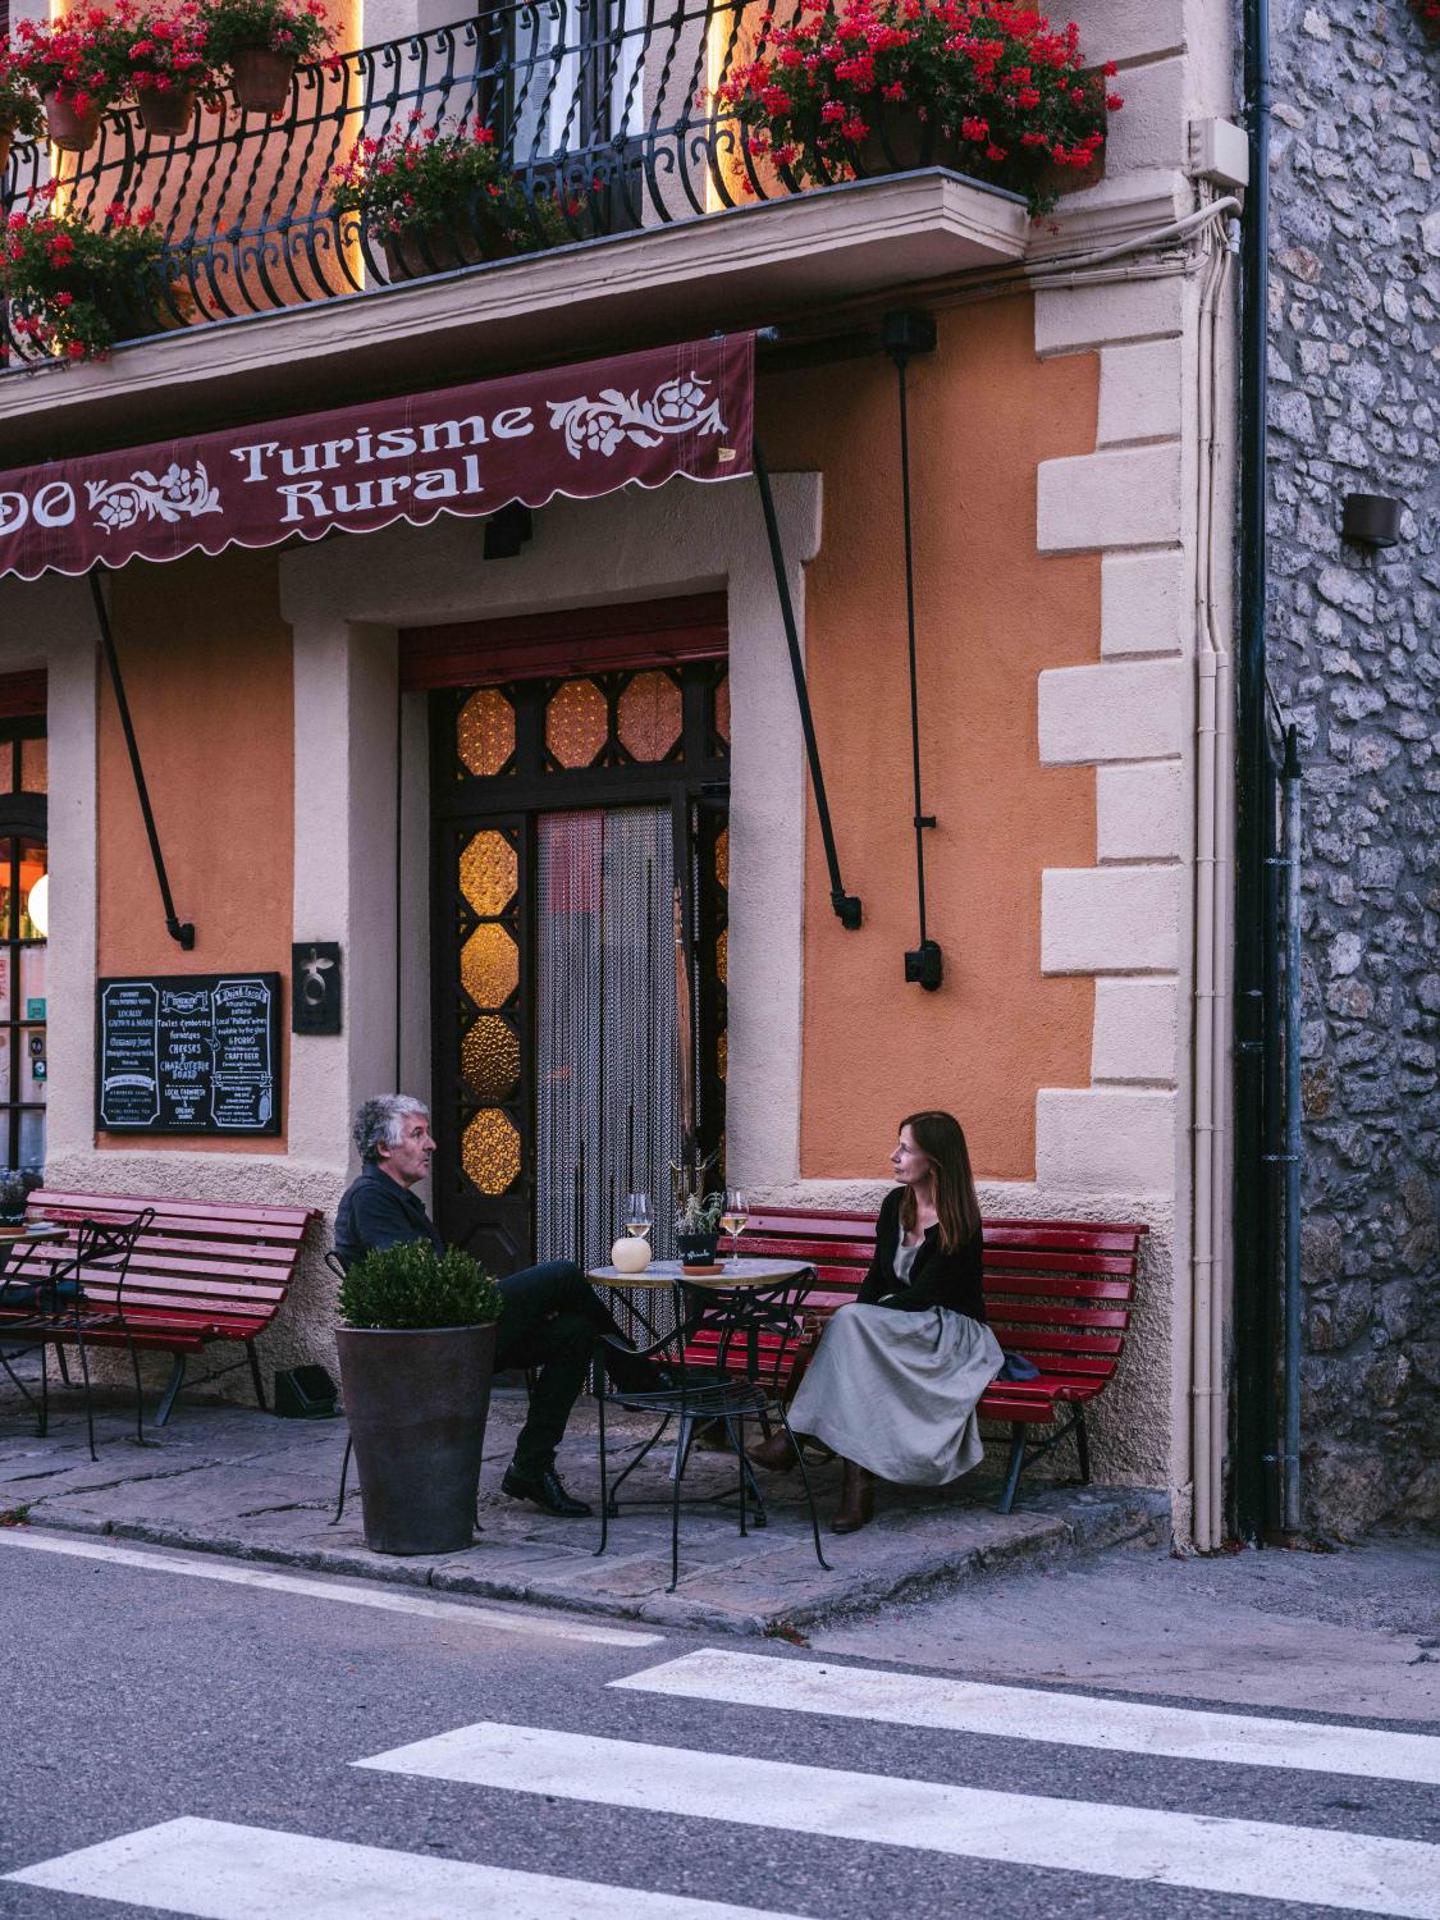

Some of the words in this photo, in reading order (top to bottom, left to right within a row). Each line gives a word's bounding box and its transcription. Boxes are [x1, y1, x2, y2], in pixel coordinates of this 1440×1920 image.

[230, 406, 535, 483] Turisme
[276, 454, 485, 523] Rural
[169, 1043, 201, 1054] CHEESES
[160, 1060, 210, 1072] CHARCUTERIE
[172, 1070, 198, 1080] BOARD
